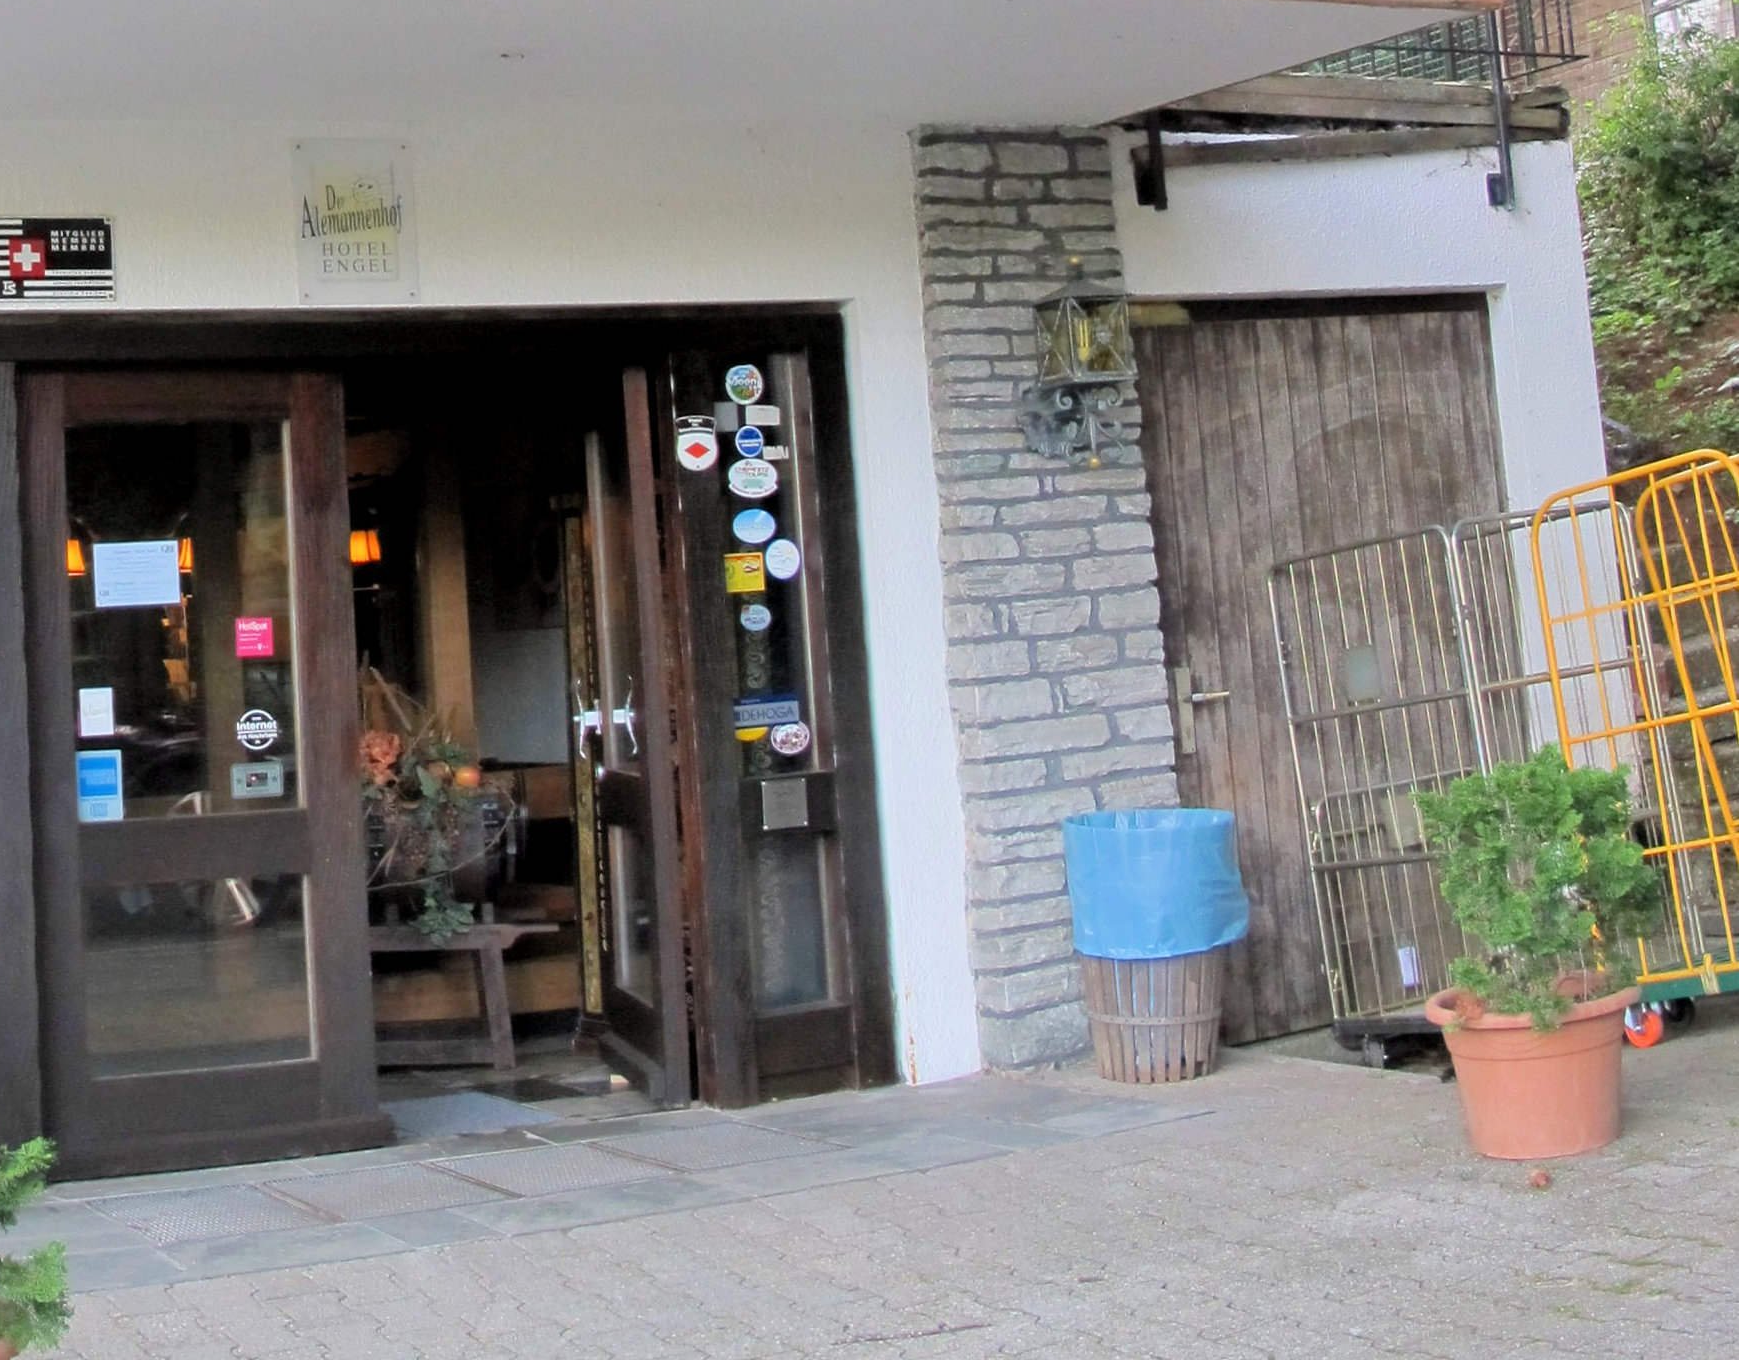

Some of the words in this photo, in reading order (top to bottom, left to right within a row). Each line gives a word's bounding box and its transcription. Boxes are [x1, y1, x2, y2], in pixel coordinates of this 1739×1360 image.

[301, 193, 403, 239] Alemannenhof
[50, 229, 105, 237] MITGLIED
[50, 244, 106, 252] MEMBRO
[322, 242, 393, 256] HOTEL
[323, 258, 394, 273] ENGEL
[740, 706, 795, 721] DEHOGA
[236, 720, 278, 731] Internet
